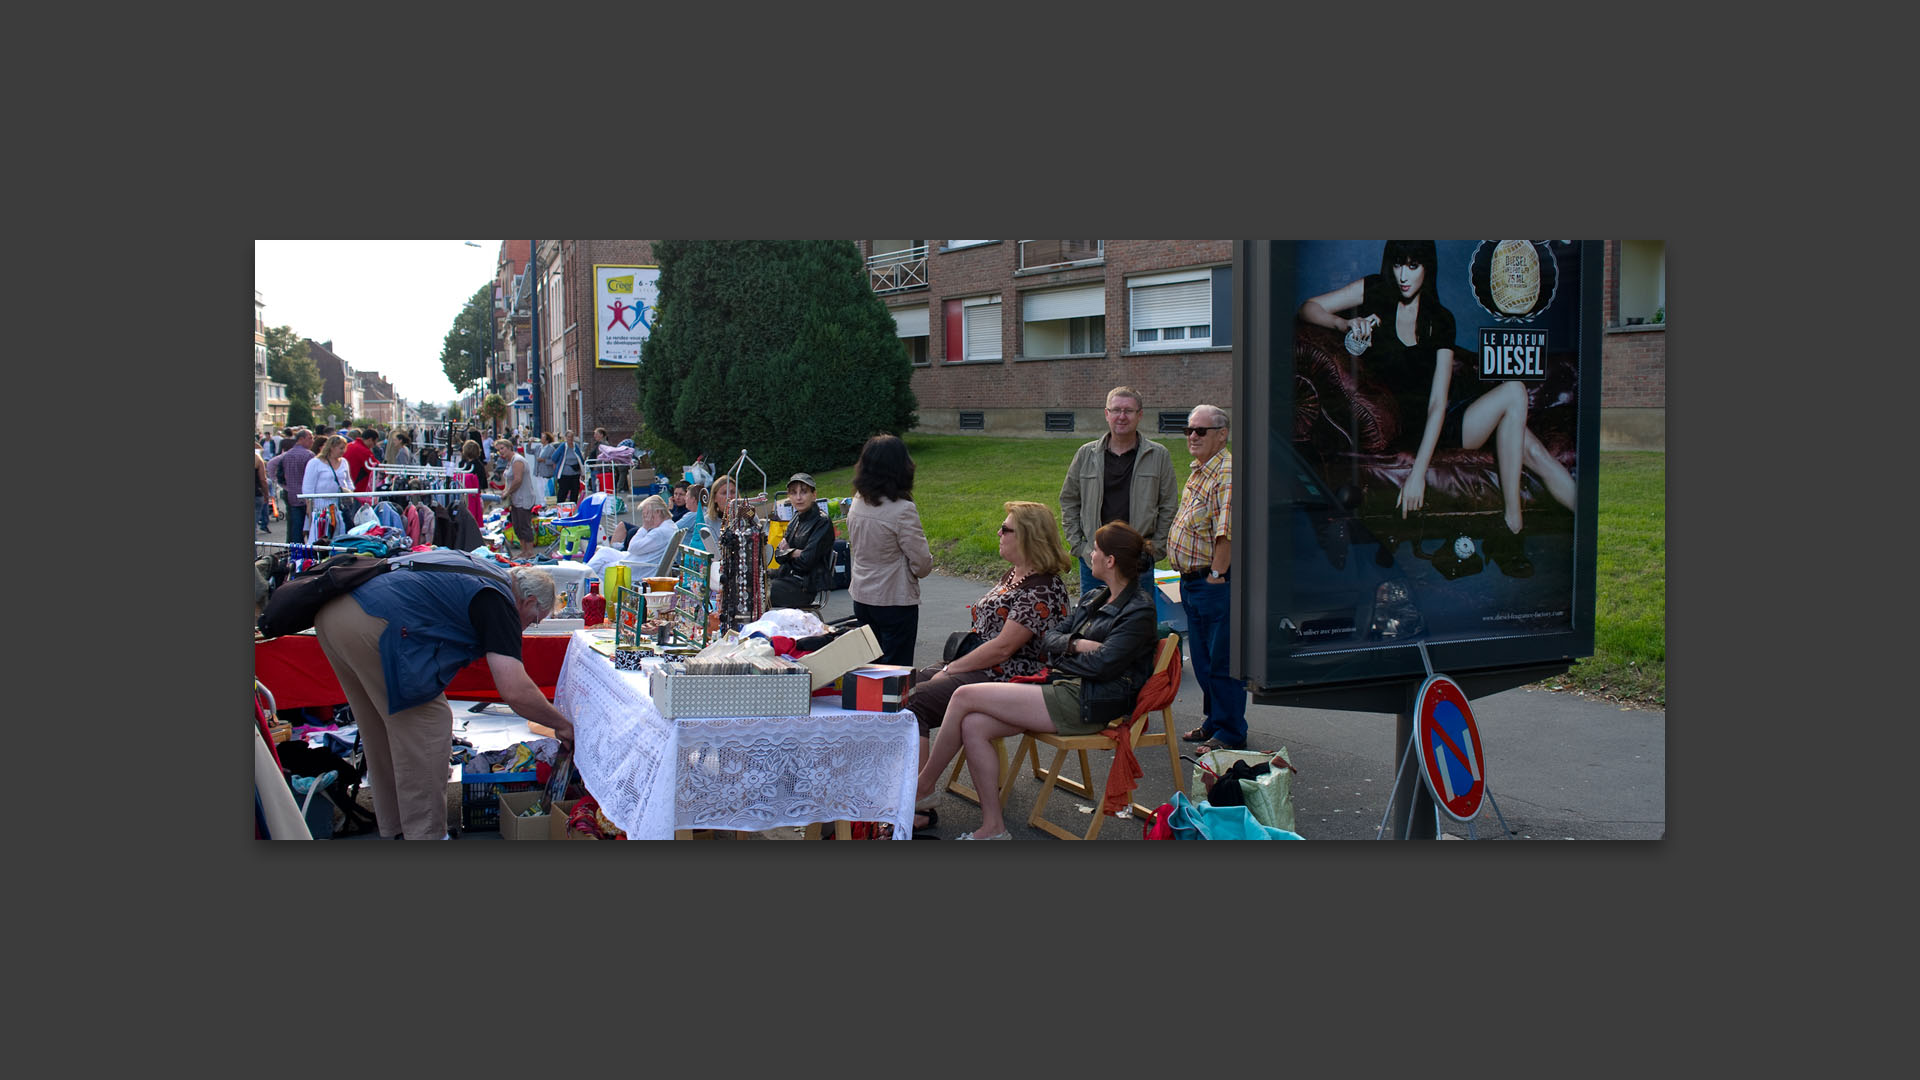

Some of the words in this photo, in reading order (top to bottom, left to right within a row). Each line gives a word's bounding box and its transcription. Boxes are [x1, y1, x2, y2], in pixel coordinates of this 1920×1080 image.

[1505, 255, 1527, 267] DIESEL
[1484, 333, 1496, 345] LE
[1503, 333, 1545, 346] PARFUM
[1484, 346, 1544, 375] DIESEL
